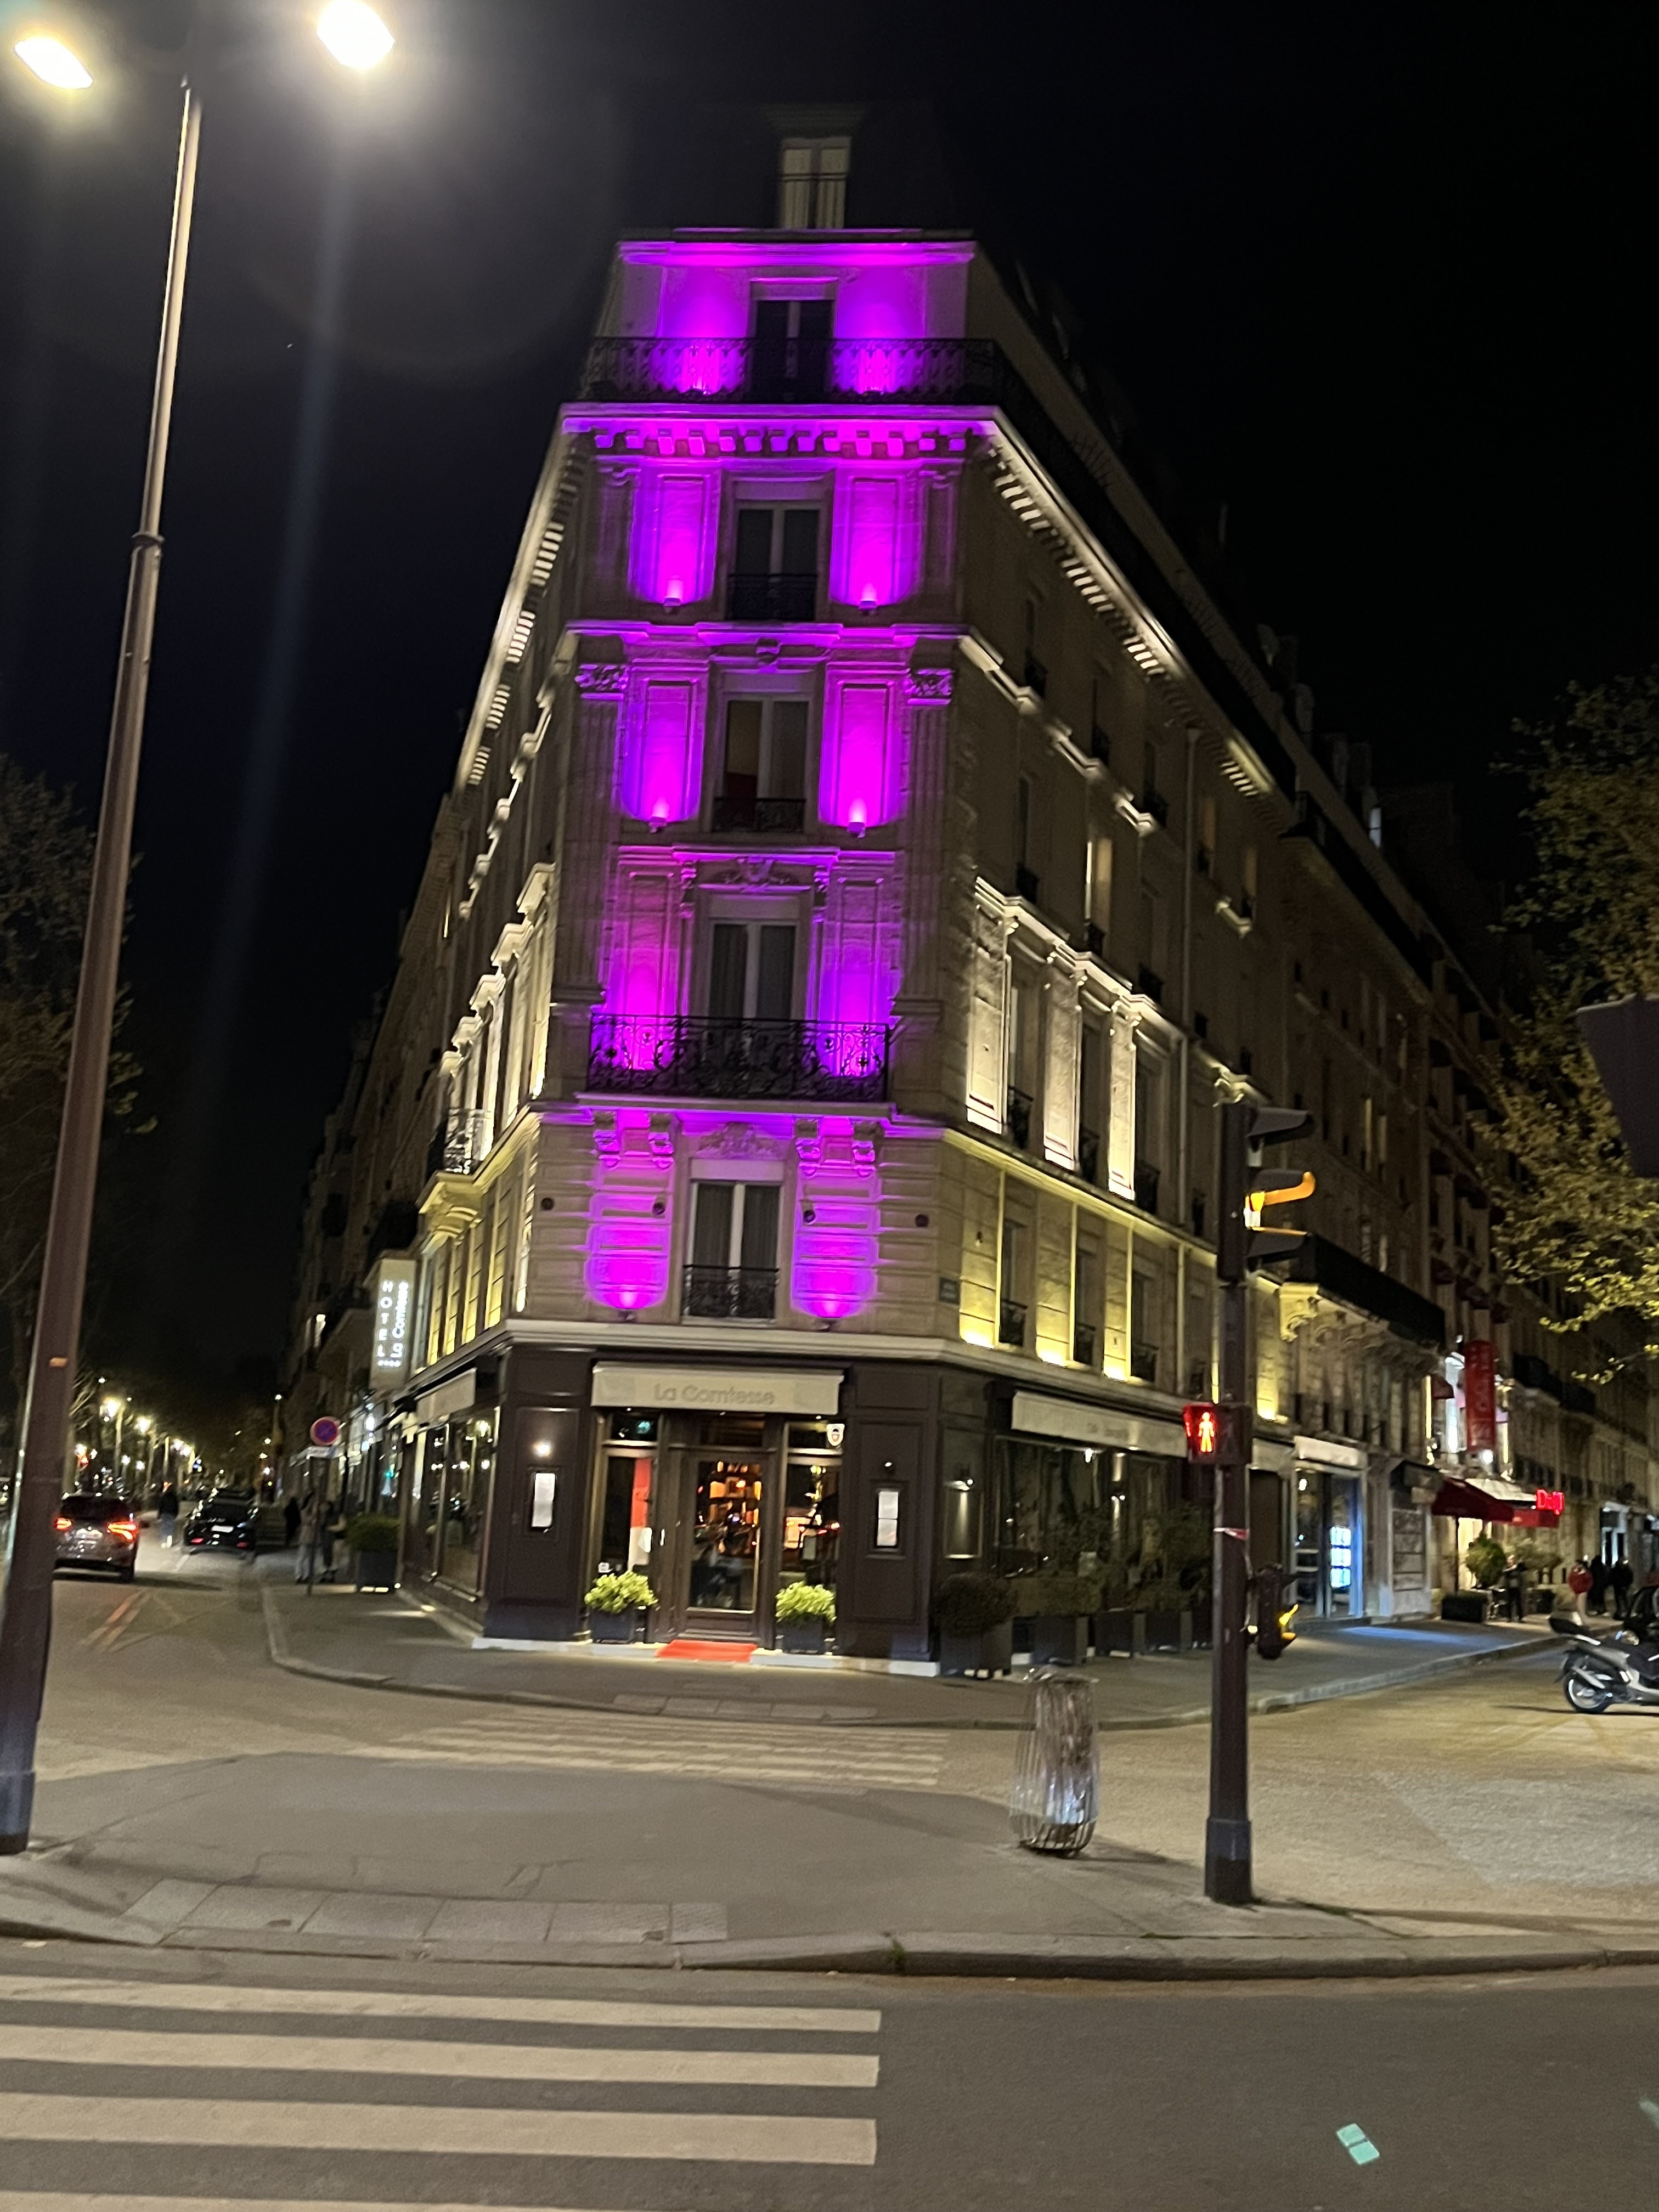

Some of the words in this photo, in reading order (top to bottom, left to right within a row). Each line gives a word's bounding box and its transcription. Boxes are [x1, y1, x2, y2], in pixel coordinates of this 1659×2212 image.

[377, 1280, 393, 1357] HOTEL
[653, 1383, 676, 1402] La
[681, 1384, 776, 1406] Comtesse
